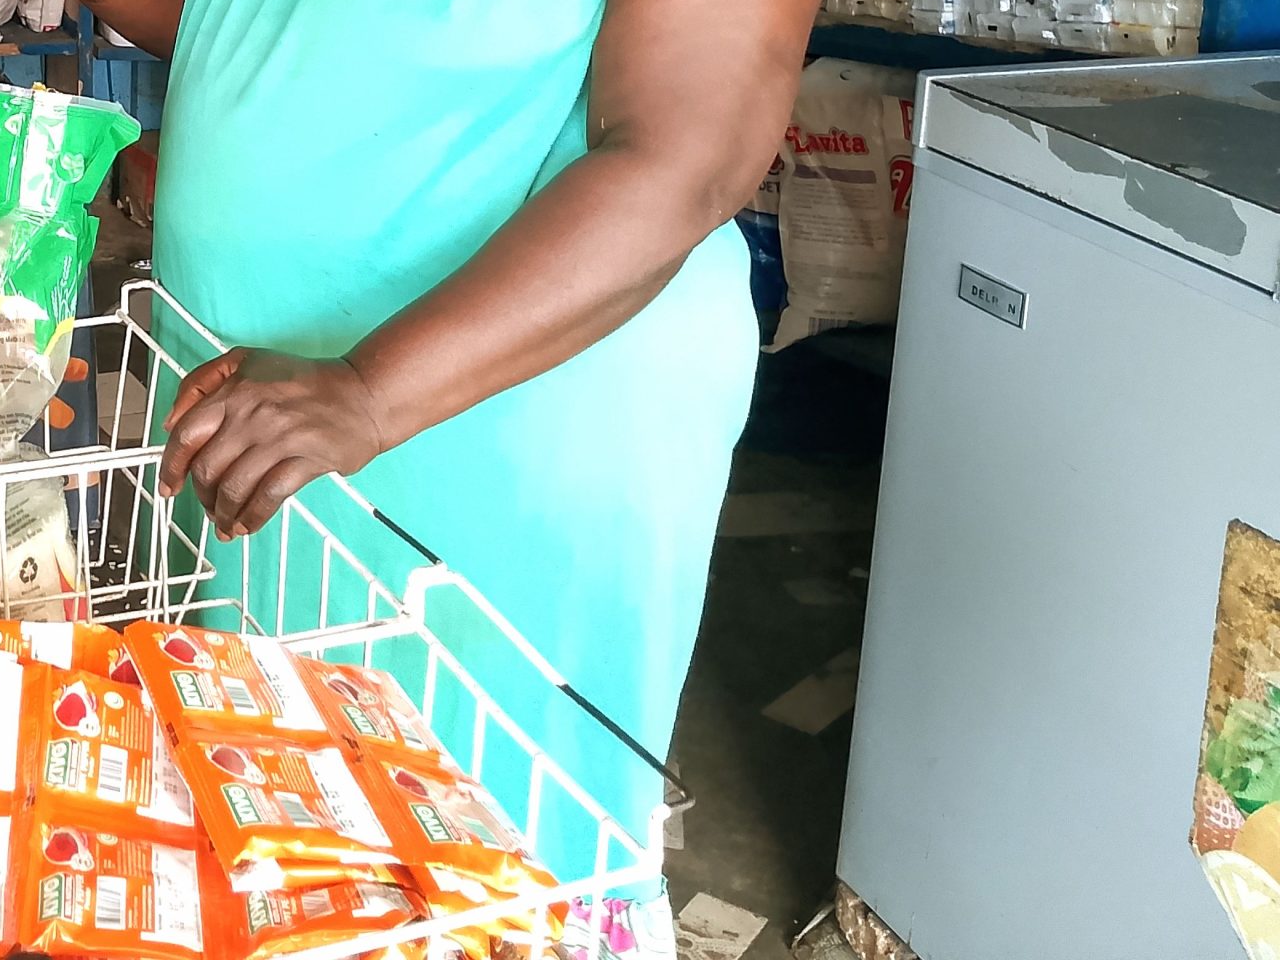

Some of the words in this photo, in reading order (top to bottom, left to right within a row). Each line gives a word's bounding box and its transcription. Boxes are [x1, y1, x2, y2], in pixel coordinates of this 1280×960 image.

[785, 126, 869, 154] Lavita
[176, 672, 203, 707] KIVO
[348, 707, 378, 736] KIVO
[47, 743, 68, 784] KIVO
[228, 787, 261, 825] KIVO
[414, 804, 451, 842] KIVO
[42, 878, 62, 919] KIVO
